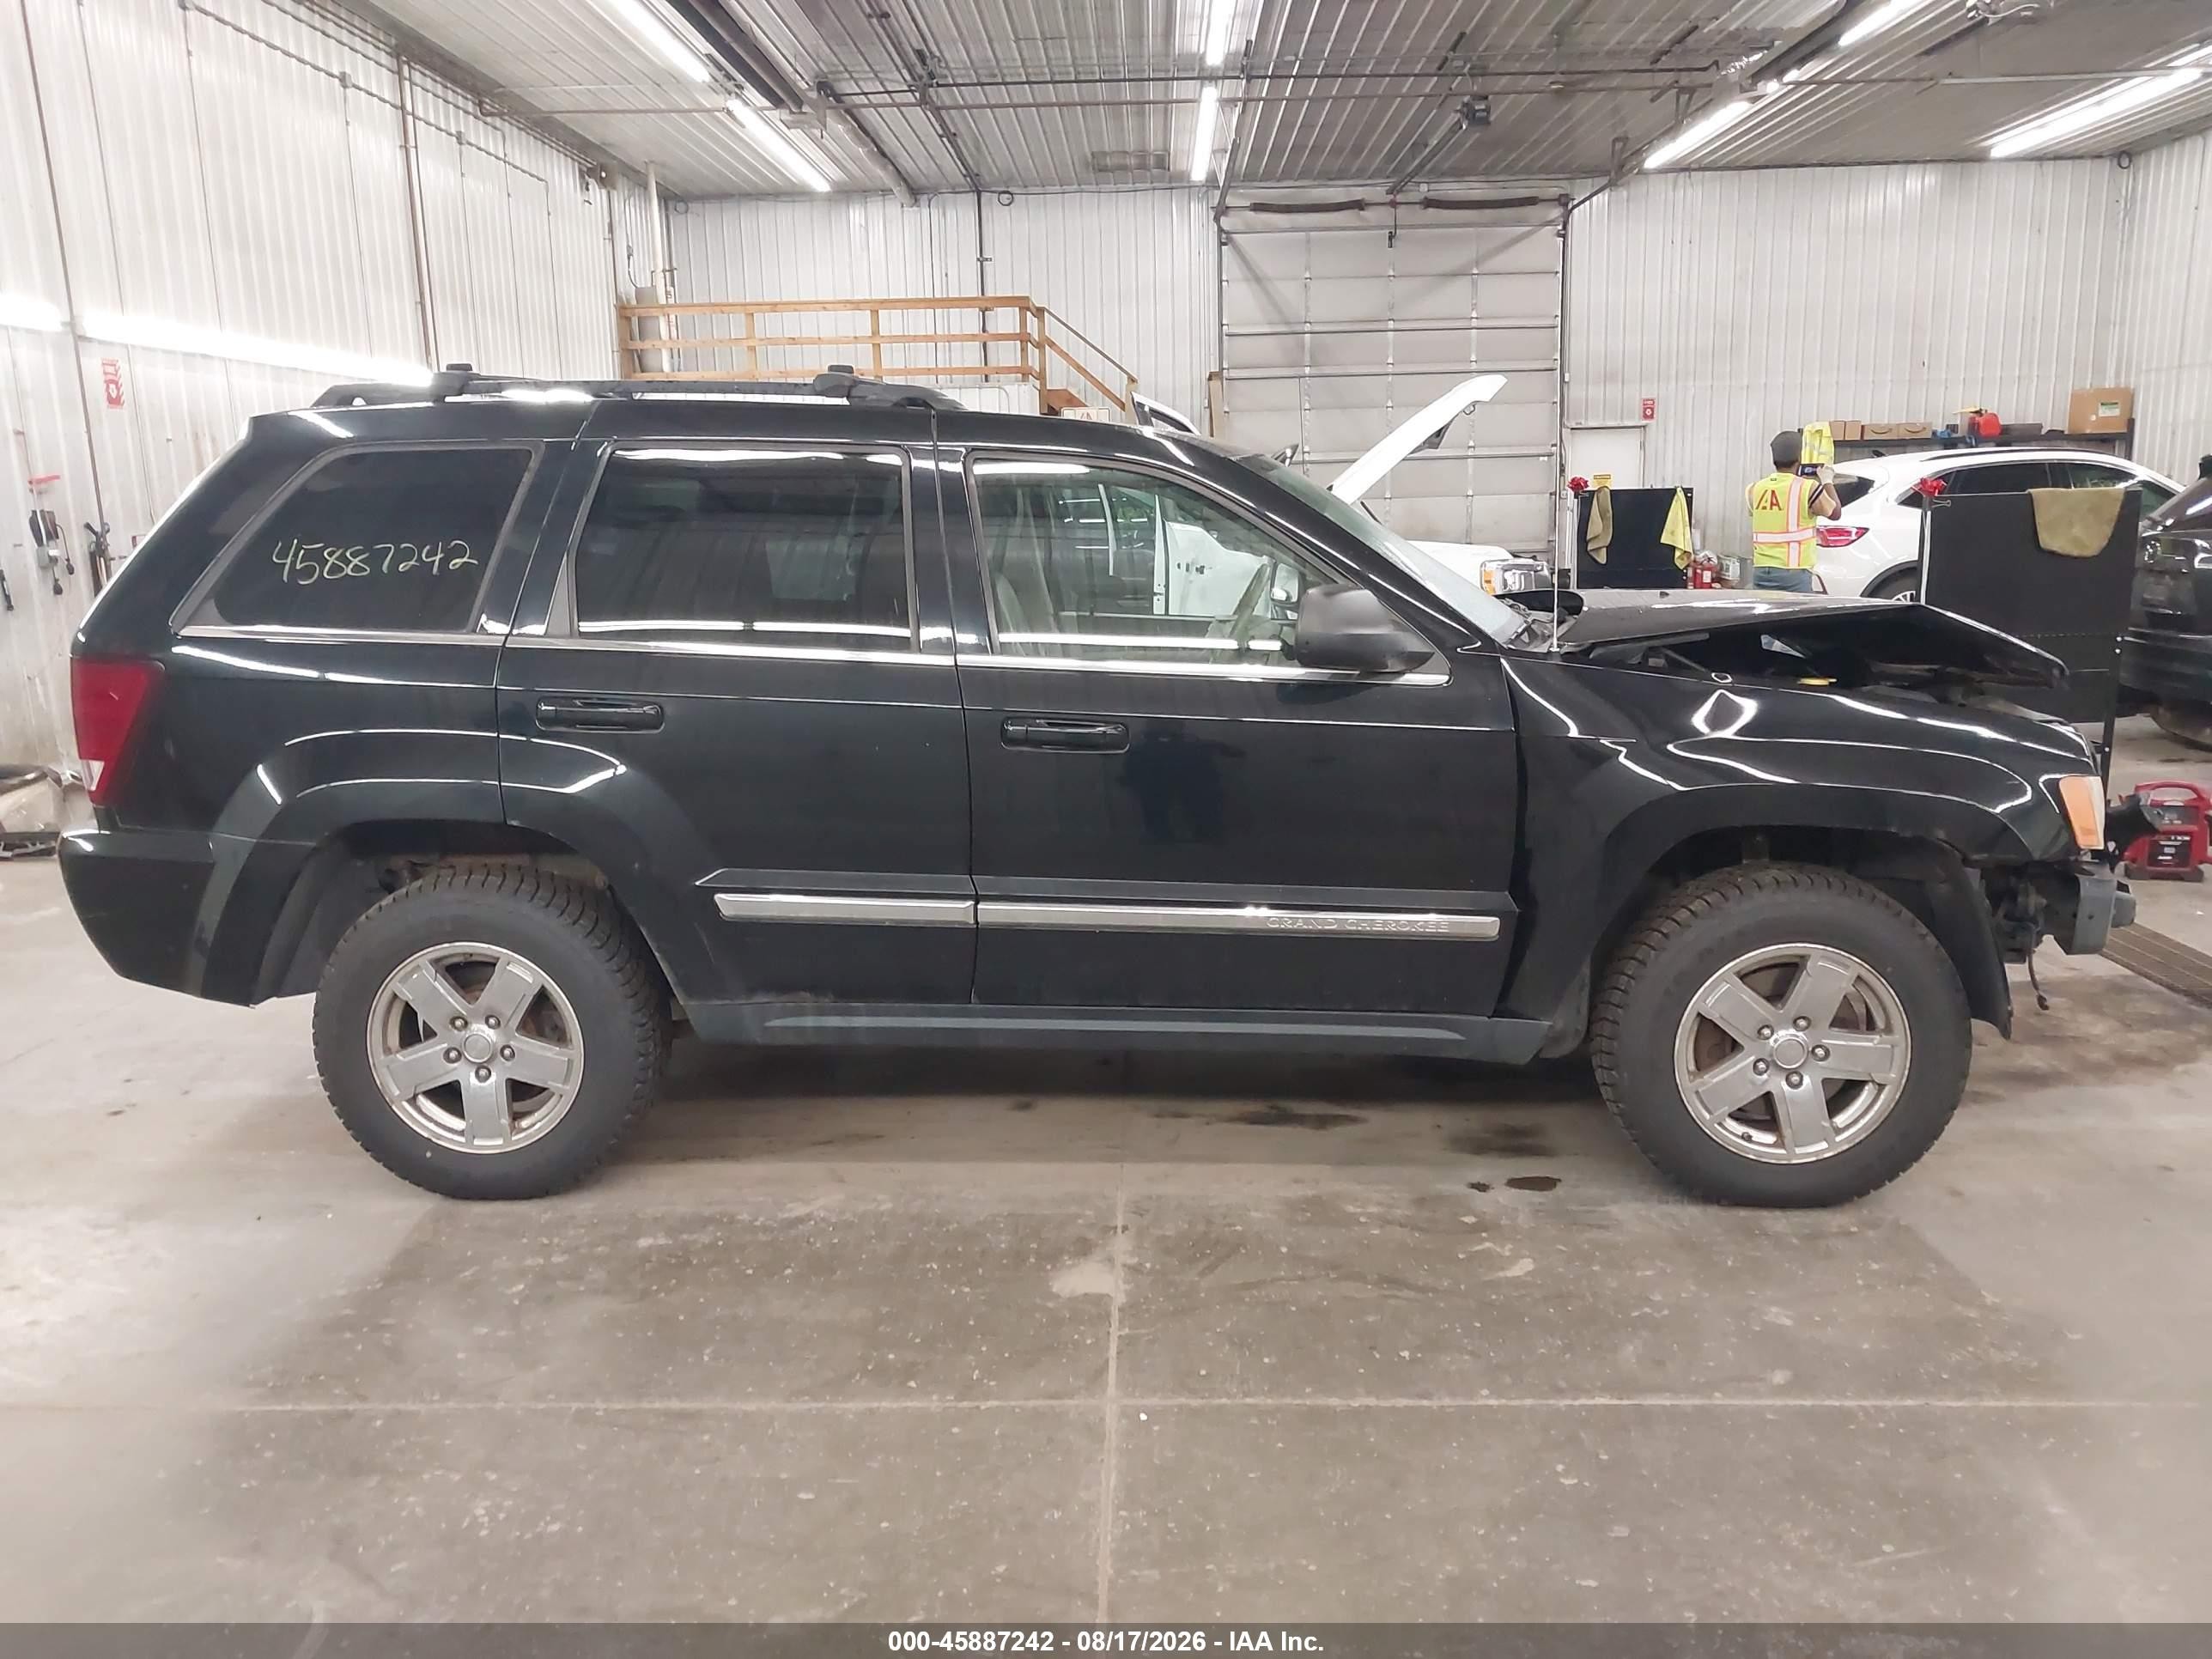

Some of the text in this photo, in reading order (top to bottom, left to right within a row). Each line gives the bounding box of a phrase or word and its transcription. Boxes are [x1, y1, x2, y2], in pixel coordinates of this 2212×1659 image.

[272, 538, 479, 586] 45887242
[1266, 917, 1450, 933] GRAND CHEROKEE
